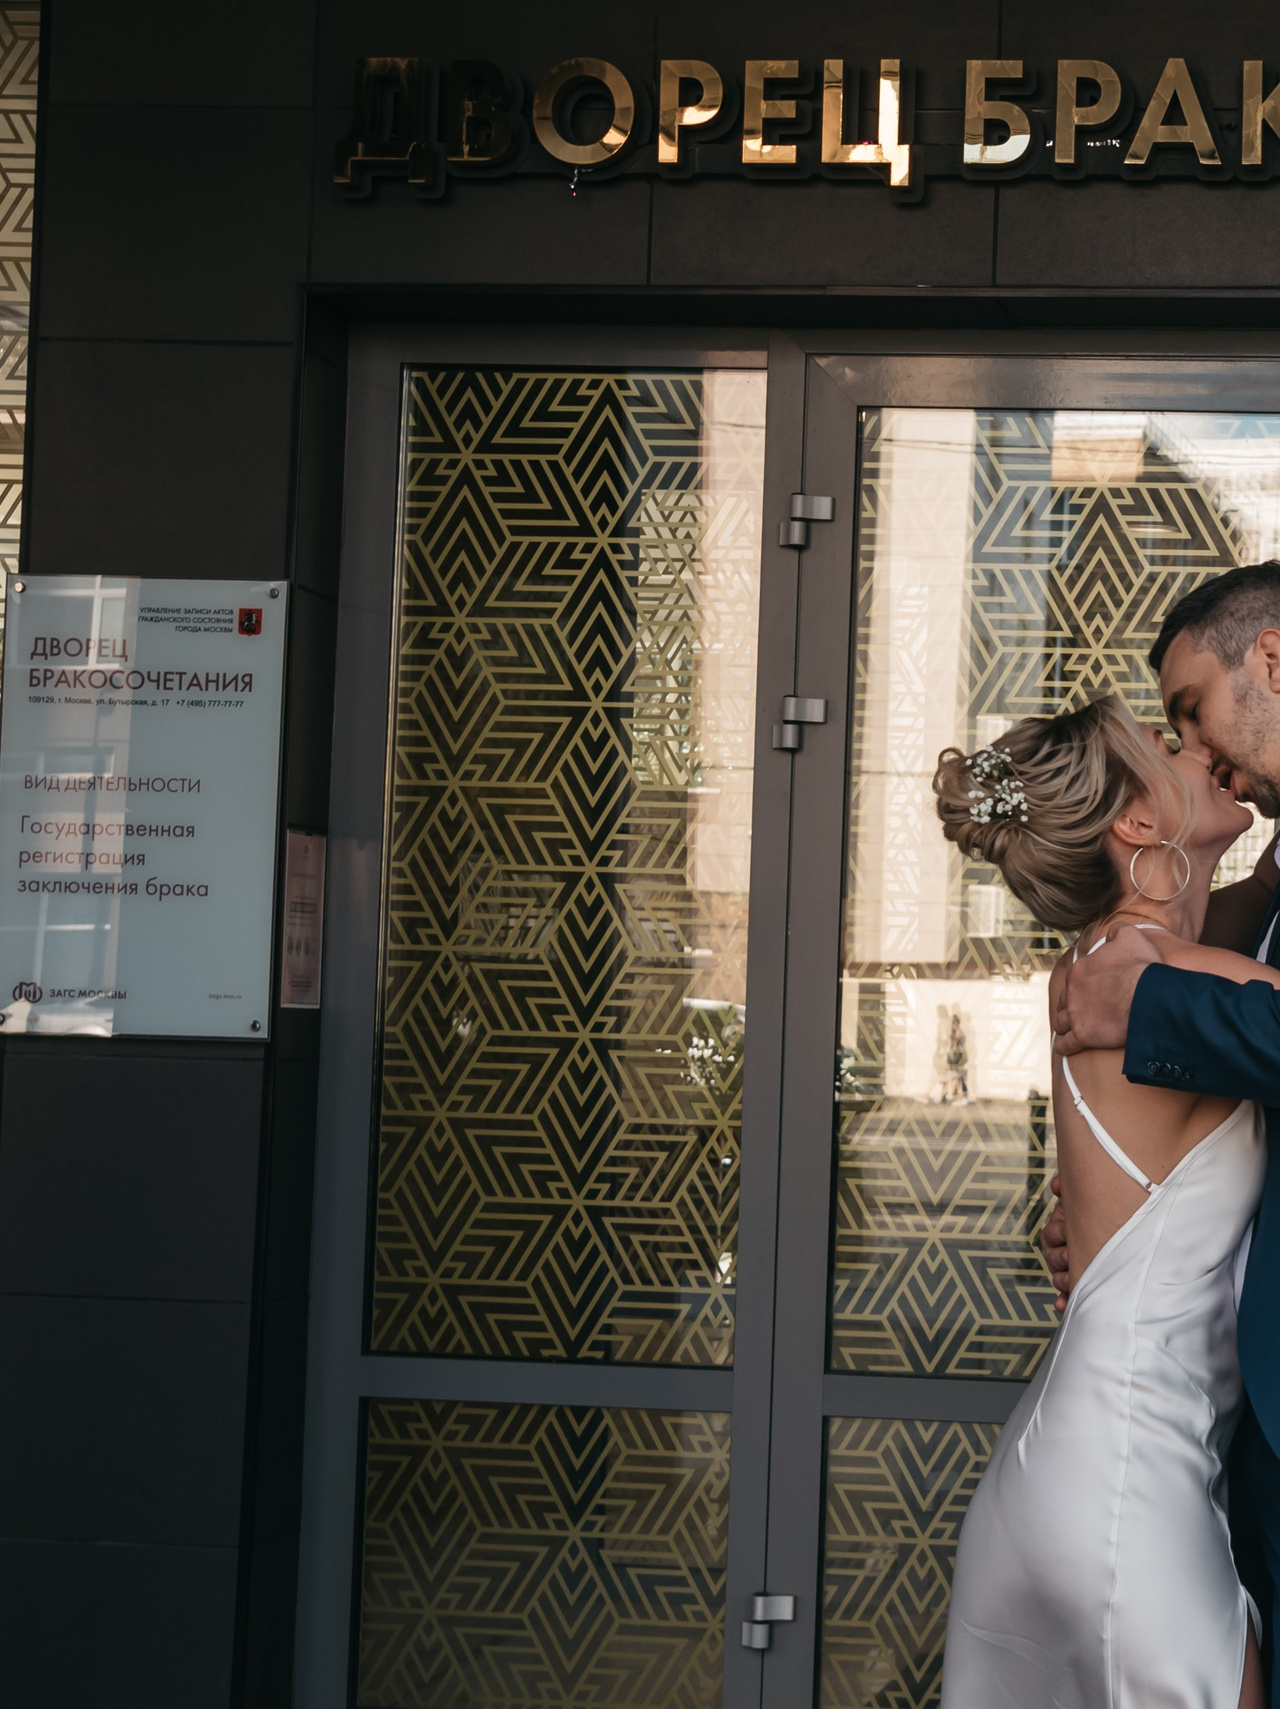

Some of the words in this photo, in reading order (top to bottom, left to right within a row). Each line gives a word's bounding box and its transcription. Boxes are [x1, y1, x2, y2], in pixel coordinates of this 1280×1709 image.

[333, 56, 910, 187] ДВОРЕЦ
[138, 616, 191, 624] ГРАЖДАНСКОГО
[140, 607, 181, 615] УПРАВЛЕНИЕ
[183, 607, 211, 615] ЗАПИСИ
[212, 608, 234, 616] АКТОВ
[175, 625, 202, 633] ГОРОДА
[30, 637, 129, 662] ДВОРЕЦ
[28, 668, 254, 693] БРАКОСОЧЕТАНИЯ
[207, 700, 244, 708] 777-77-77
[24, 774, 61, 792] ВИД
[65, 775, 201, 793] ДЕЯТЕЛЬНОСТИ
[20, 815, 196, 841] Государственная
[18, 850, 146, 869] регистрация
[17, 878, 139, 896] заключения
[145, 876, 209, 901] брака
[49, 989, 76, 998] ЗАГС
[78, 989, 127, 999] МОСКВЫ
